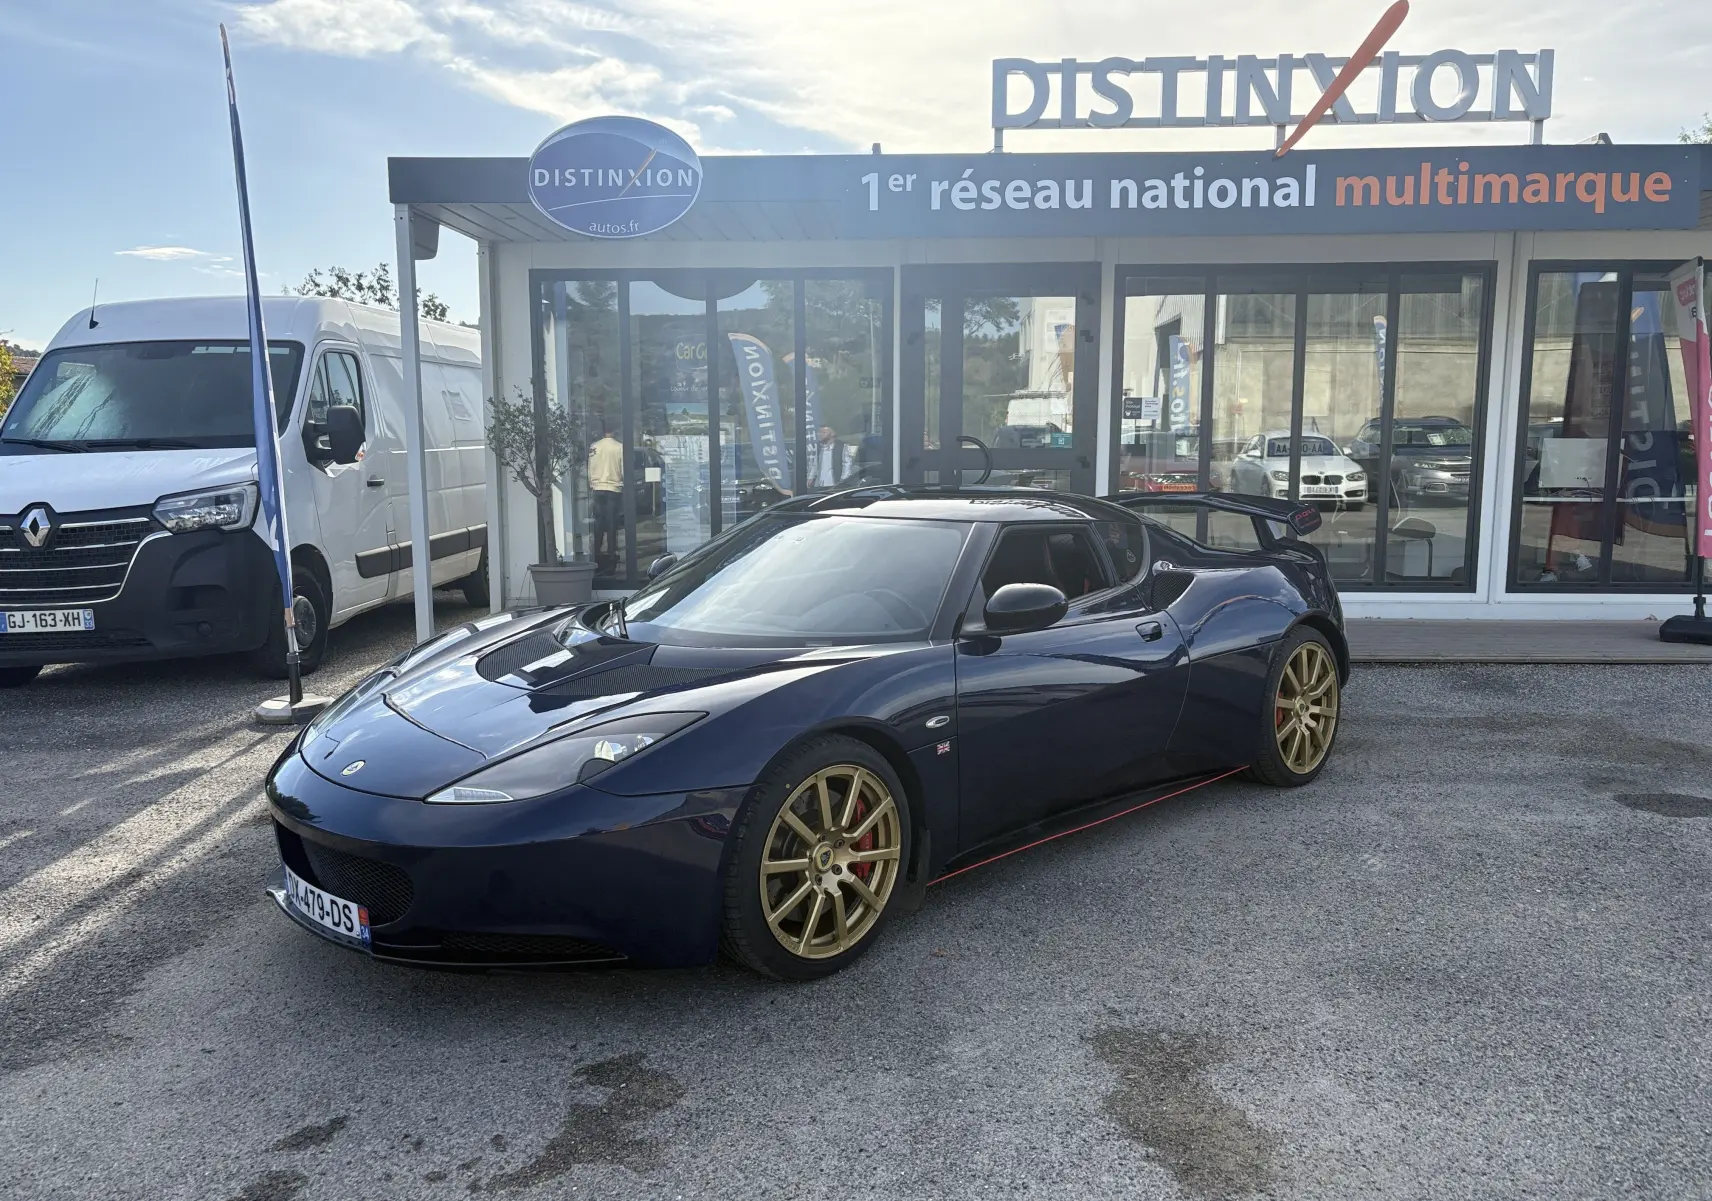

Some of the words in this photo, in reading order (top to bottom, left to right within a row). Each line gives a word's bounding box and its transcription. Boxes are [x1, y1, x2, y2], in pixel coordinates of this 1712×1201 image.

[992, 48, 1555, 127] DISTINXION
[534, 168, 693, 187] DISTINXION
[930, 168, 1093, 211] réseau
[1110, 164, 1316, 209] national
[1336, 161, 1672, 214] multimarque
[588, 220, 640, 234] autos.fr
[7, 612, 82, 629] GJ-163-XH
[288, 871, 355, 933] DX-479-DS
